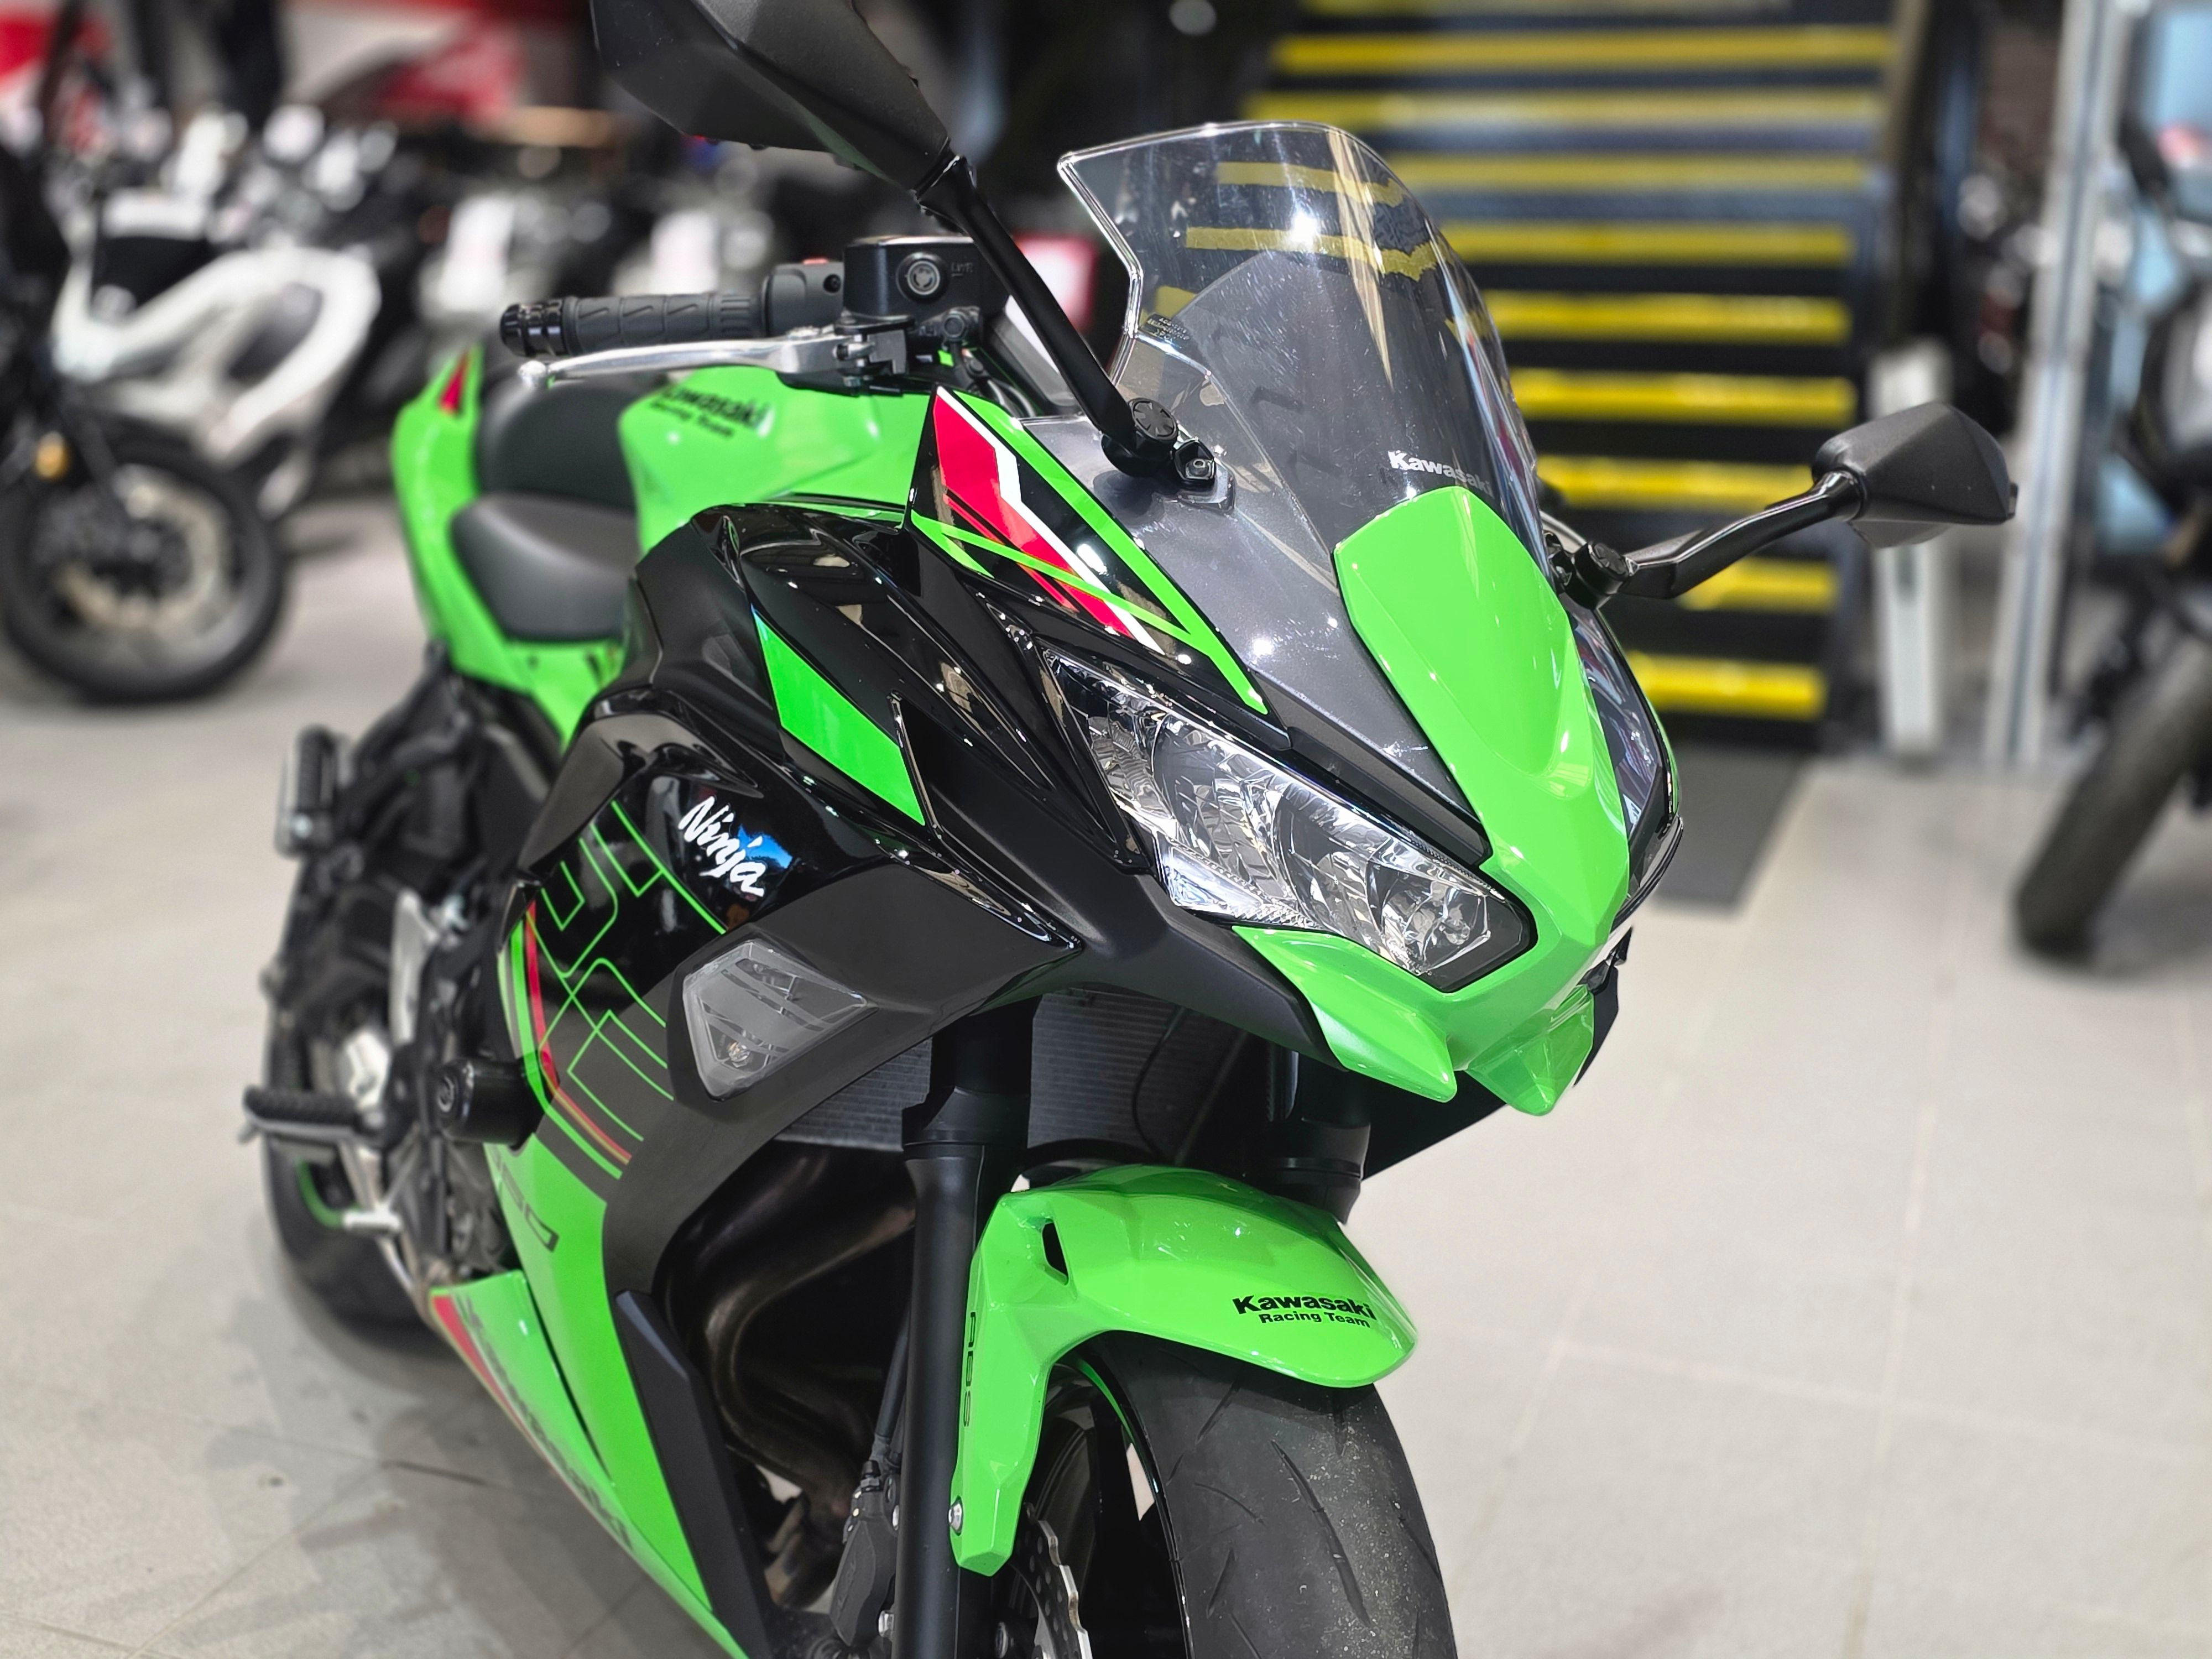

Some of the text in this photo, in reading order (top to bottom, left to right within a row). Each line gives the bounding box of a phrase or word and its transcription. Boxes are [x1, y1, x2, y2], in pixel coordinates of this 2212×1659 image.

[1388, 450, 1494, 498] Kawasaki
[678, 796, 765, 898] Ninja
[1232, 1295, 1376, 1320] Kawasaki
[1259, 1311, 1370, 1328] Racing Team
[963, 1312, 976, 1427] ABS
